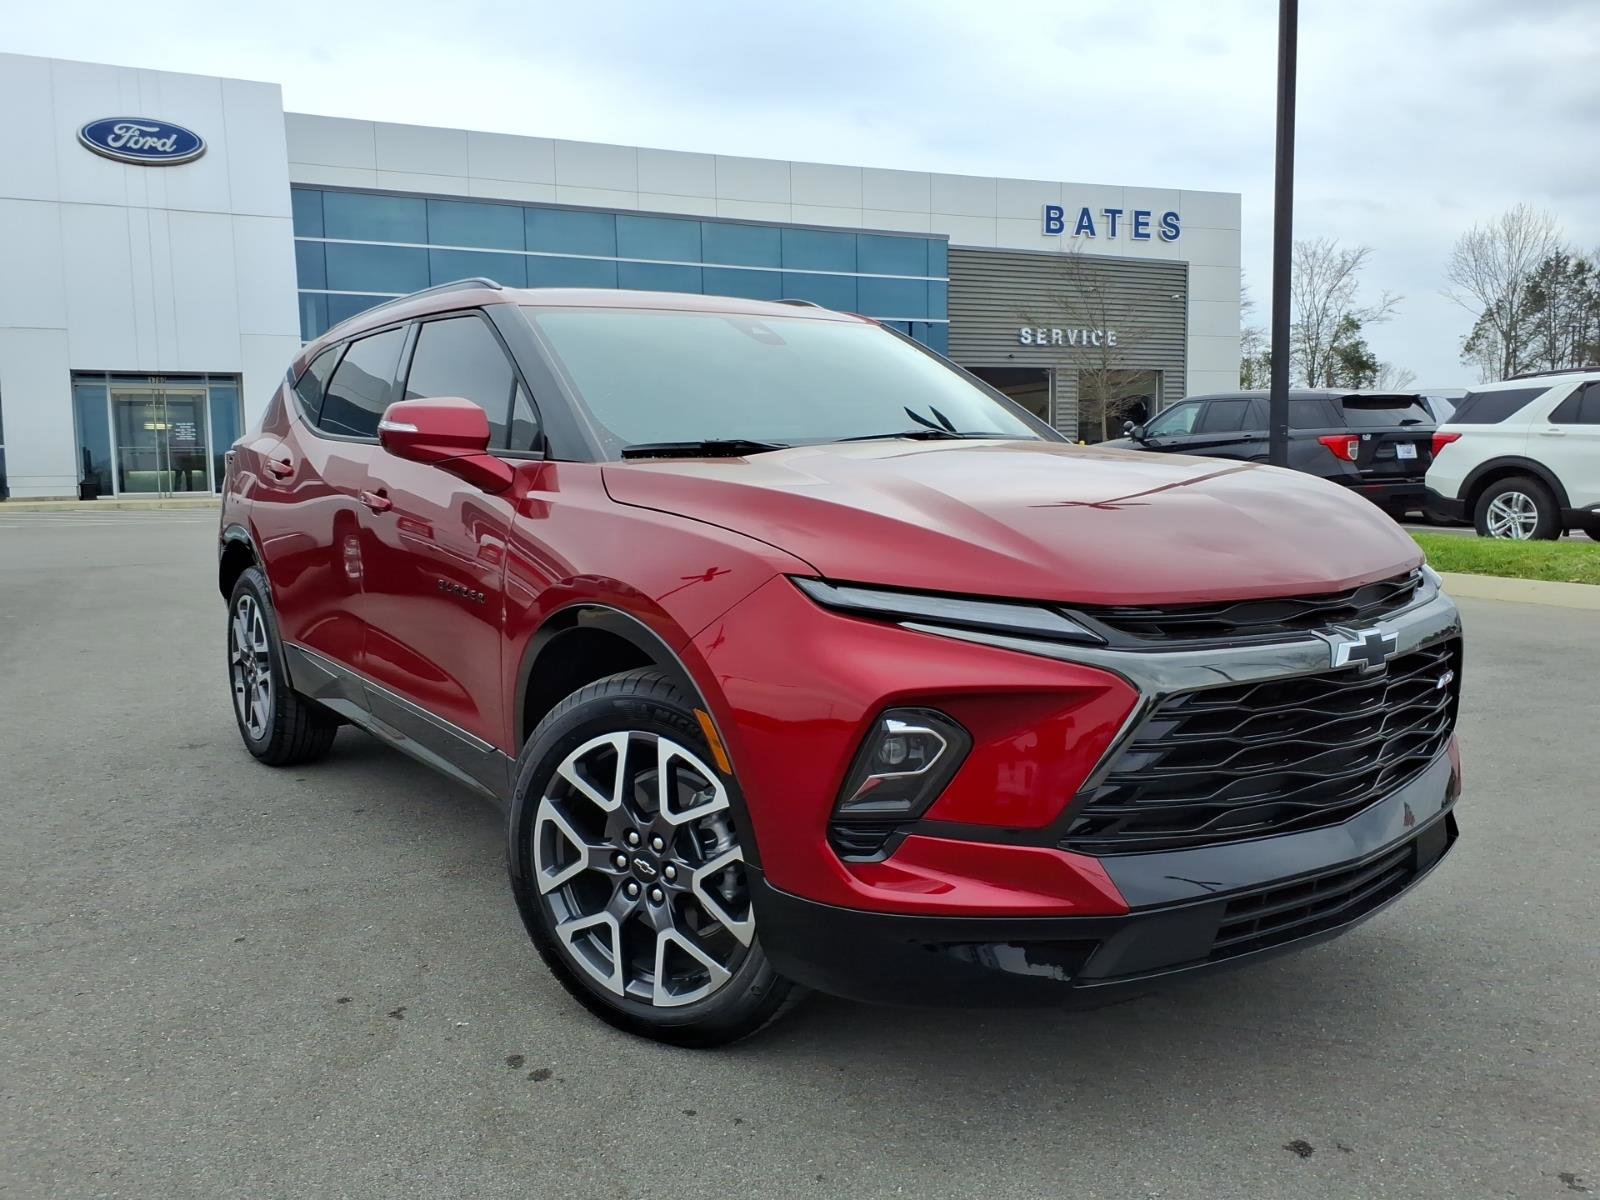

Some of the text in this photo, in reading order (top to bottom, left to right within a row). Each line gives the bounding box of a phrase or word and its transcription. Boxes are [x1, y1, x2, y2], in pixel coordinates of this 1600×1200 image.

[107, 123, 178, 152] Ford
[1043, 203, 1181, 242] BATES
[1020, 327, 1117, 346] SERVICE
